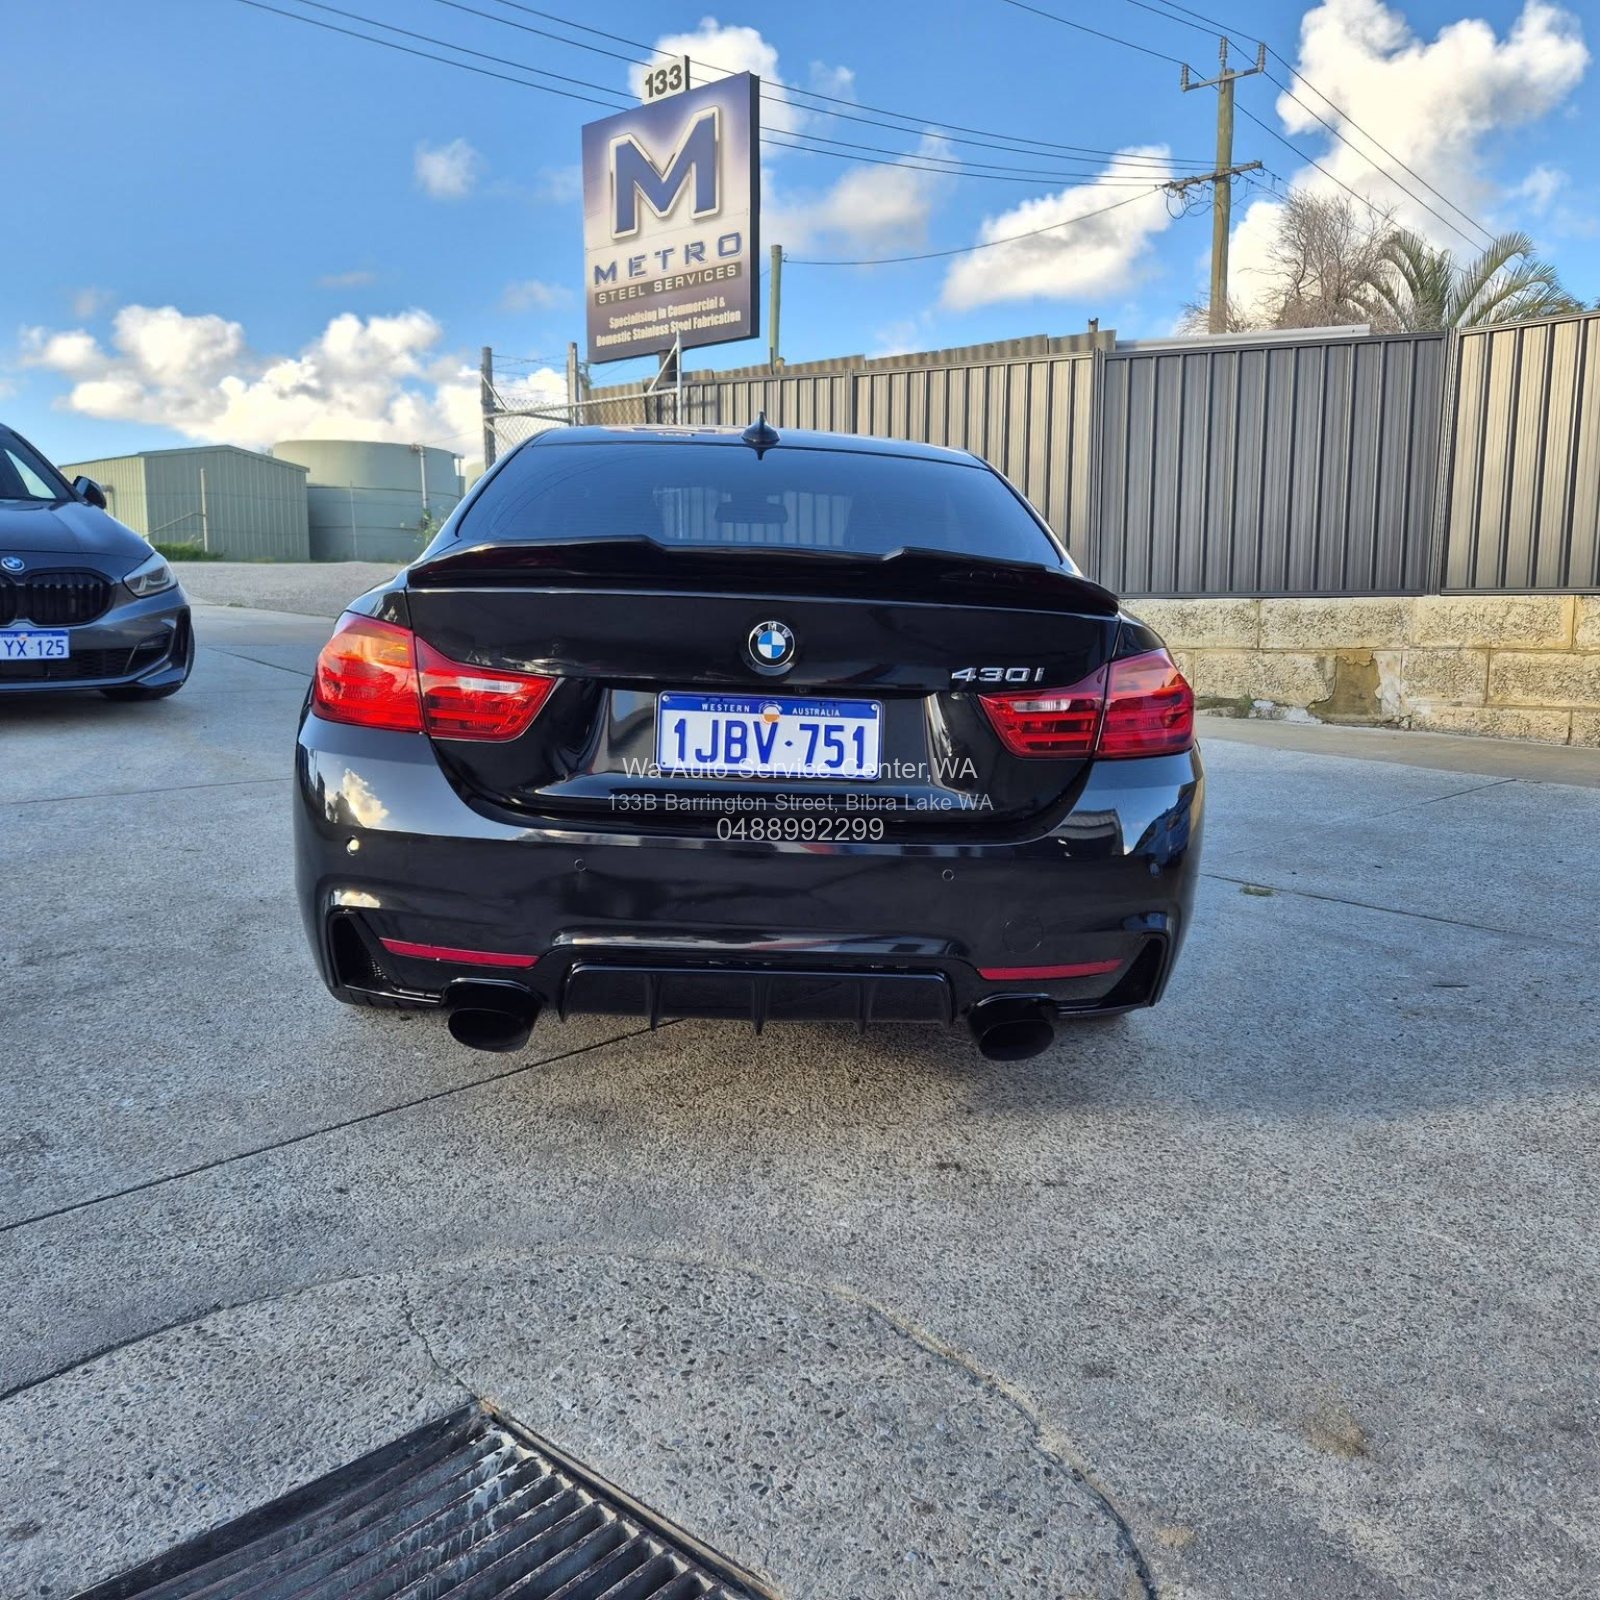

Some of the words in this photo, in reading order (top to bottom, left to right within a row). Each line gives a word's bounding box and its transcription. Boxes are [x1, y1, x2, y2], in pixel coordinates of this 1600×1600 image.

[645, 65, 682, 97] 133
[610, 105, 719, 240] M
[594, 232, 742, 286] METRO
[598, 285, 645, 304] STEEL
[653, 264, 736, 292] SERVICES
[596, 330, 632, 347] Domestic
[632, 323, 669, 340] Stainless
[670, 318, 692, 333] Steel
[693, 309, 741, 329] Fabrication
[609, 309, 657, 329] Specialising
[667, 296, 718, 318] Commercial
[719, 296, 725, 308] &
[754, 623, 792, 639] BMW
[701, 702, 751, 713] WESTERN
[792, 707, 841, 717] AUSTRALIA
